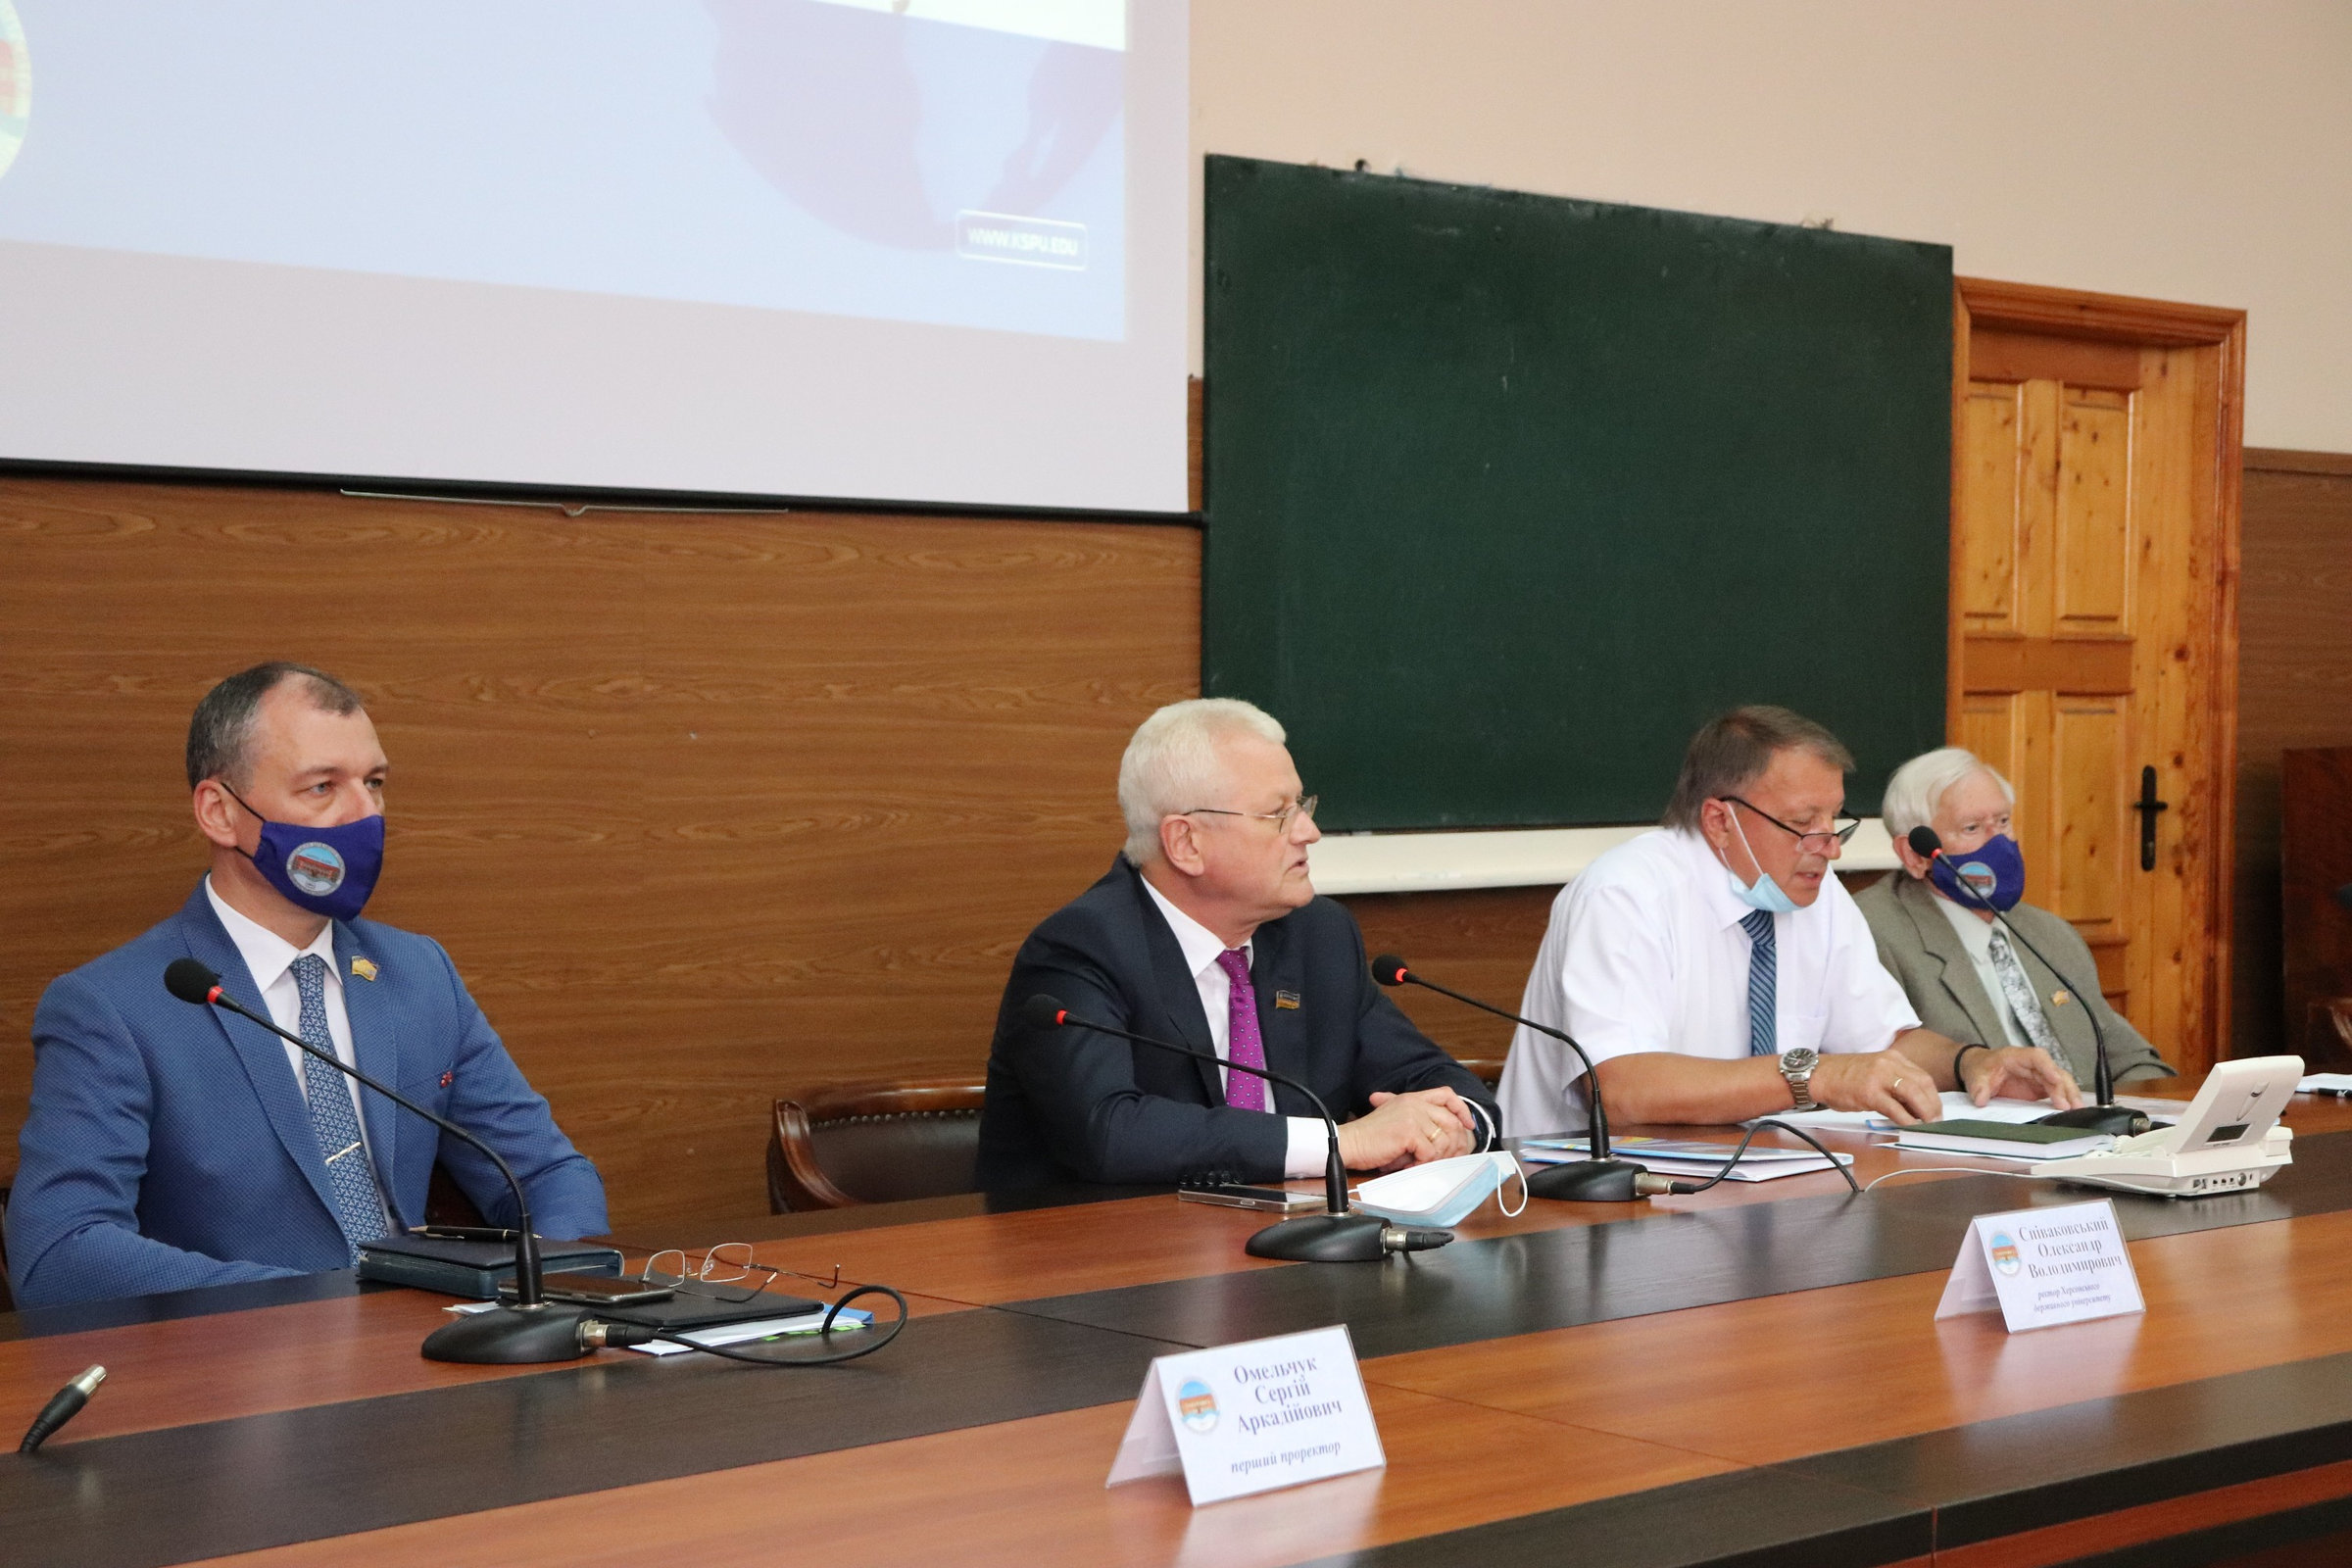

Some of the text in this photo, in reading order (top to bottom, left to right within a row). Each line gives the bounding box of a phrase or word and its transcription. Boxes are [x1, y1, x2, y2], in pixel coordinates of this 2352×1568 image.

[966, 227, 1078, 256] WWW.KSPU.EDU
[2019, 1216, 2109, 1242] Співаковський
[2037, 1239, 2102, 1258] Олександр
[2028, 1254, 2122, 1279] Володимирович
[1234, 1356, 1317, 1384] Омельчук
[1254, 1377, 1310, 1404] Сергій
[1238, 1399, 1342, 1435] Аркадійович
[1231, 1441, 1341, 1475] перший проректор
